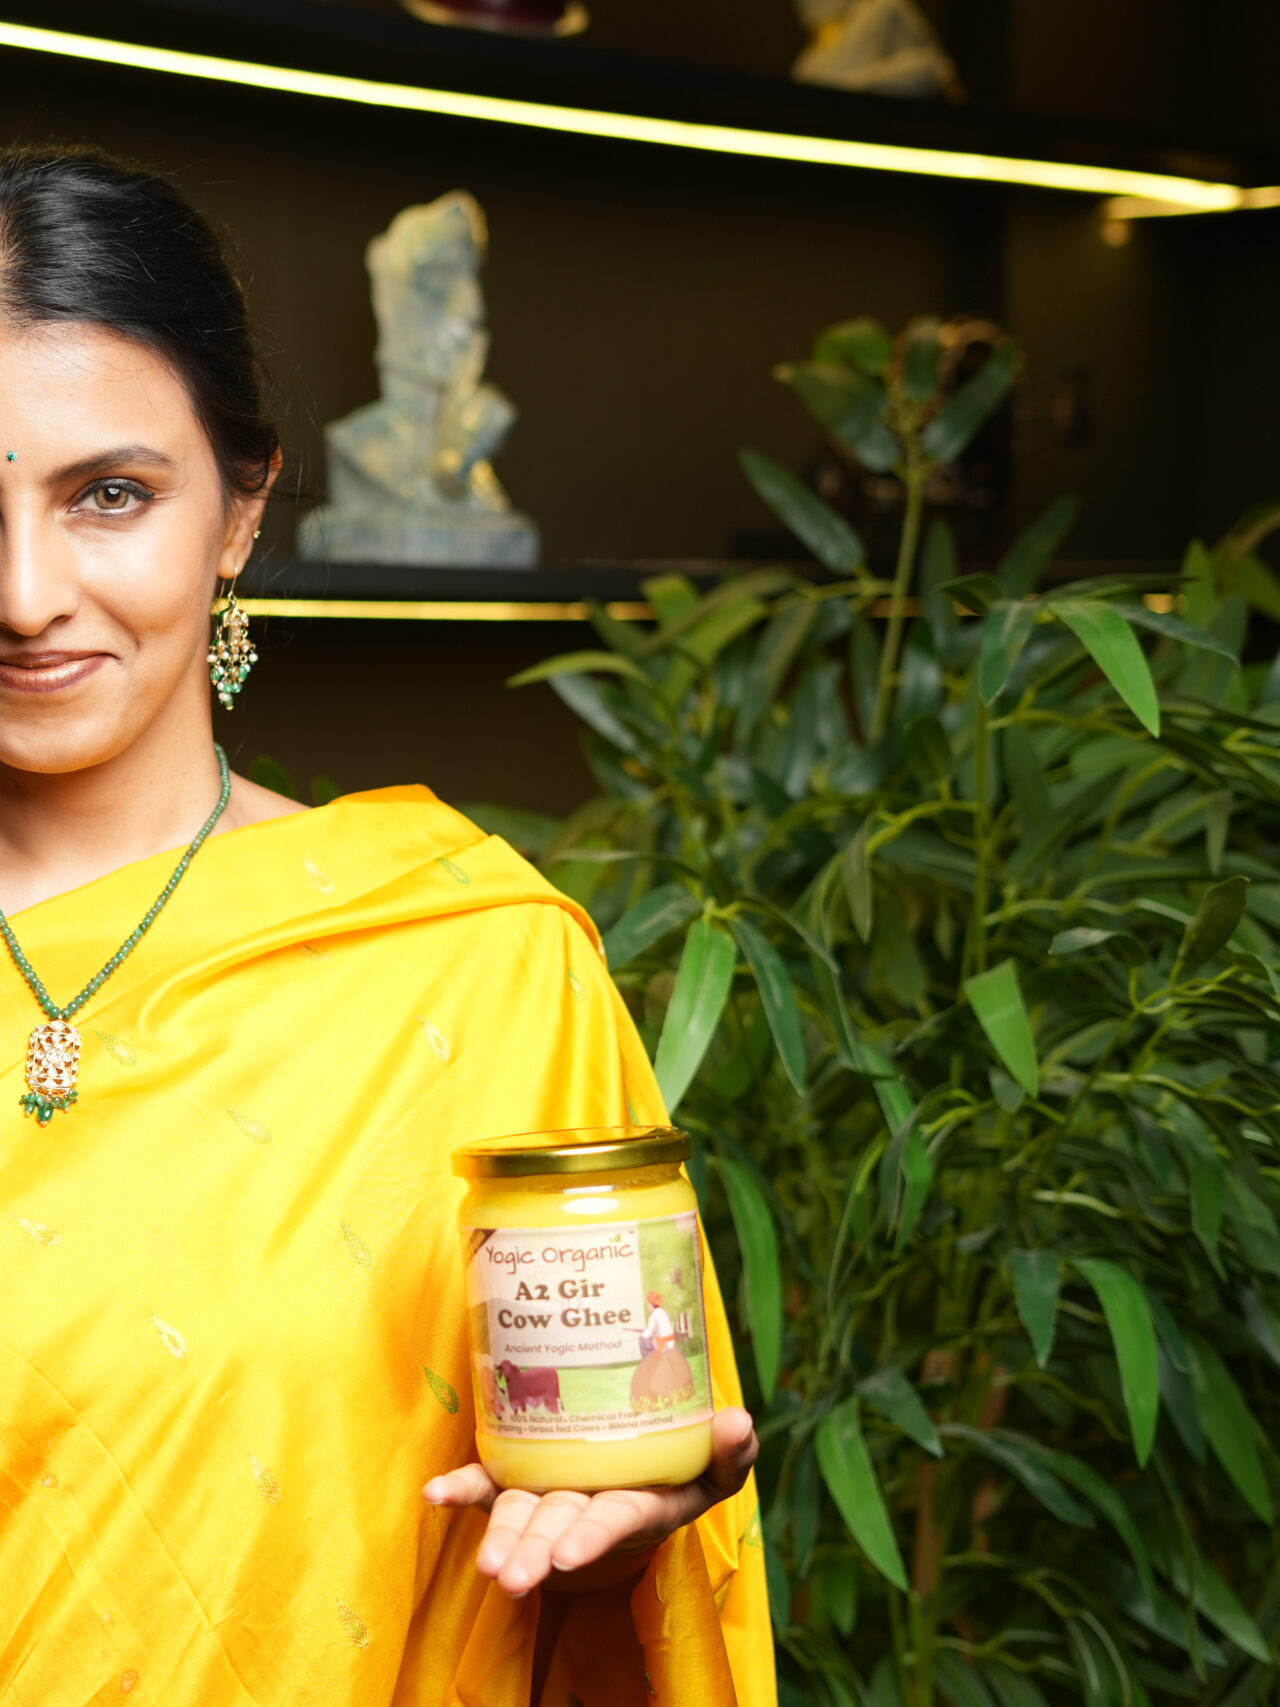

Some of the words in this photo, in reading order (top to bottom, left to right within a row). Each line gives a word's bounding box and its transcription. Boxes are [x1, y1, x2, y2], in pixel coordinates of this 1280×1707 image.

[485, 1245, 535, 1275] Yogic
[541, 1244, 634, 1272] Organic
[515, 1281, 550, 1301] A2
[558, 1279, 605, 1299] Gir
[498, 1309, 552, 1329] Cow
[560, 1307, 632, 1328] Ghee
[504, 1343, 542, 1353] Ancient
[544, 1343, 575, 1355] Yogic
[577, 1340, 622, 1351] Method
[568, 1412, 616, 1423] Chemical
